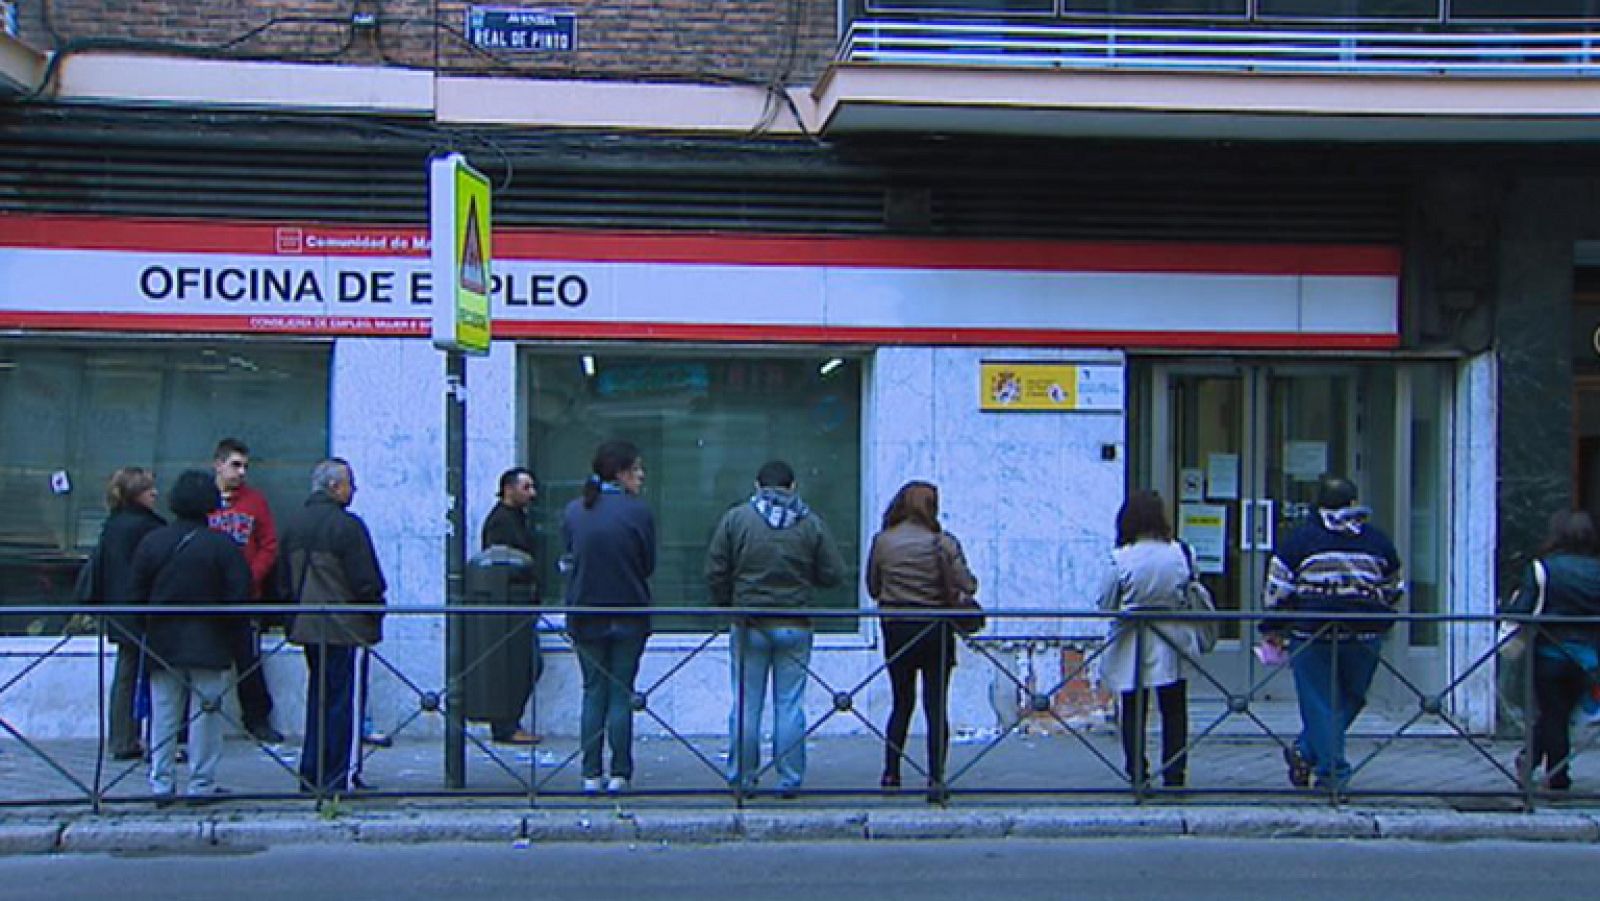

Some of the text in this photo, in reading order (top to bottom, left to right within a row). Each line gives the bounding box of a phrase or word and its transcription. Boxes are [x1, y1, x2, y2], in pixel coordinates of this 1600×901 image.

[474, 28, 569, 49] REAL DE PINTO
[305, 235, 386, 248] Comunidad
[391, 236, 409, 248] de
[139, 265, 588, 307] OFICINA DE EPLEO
